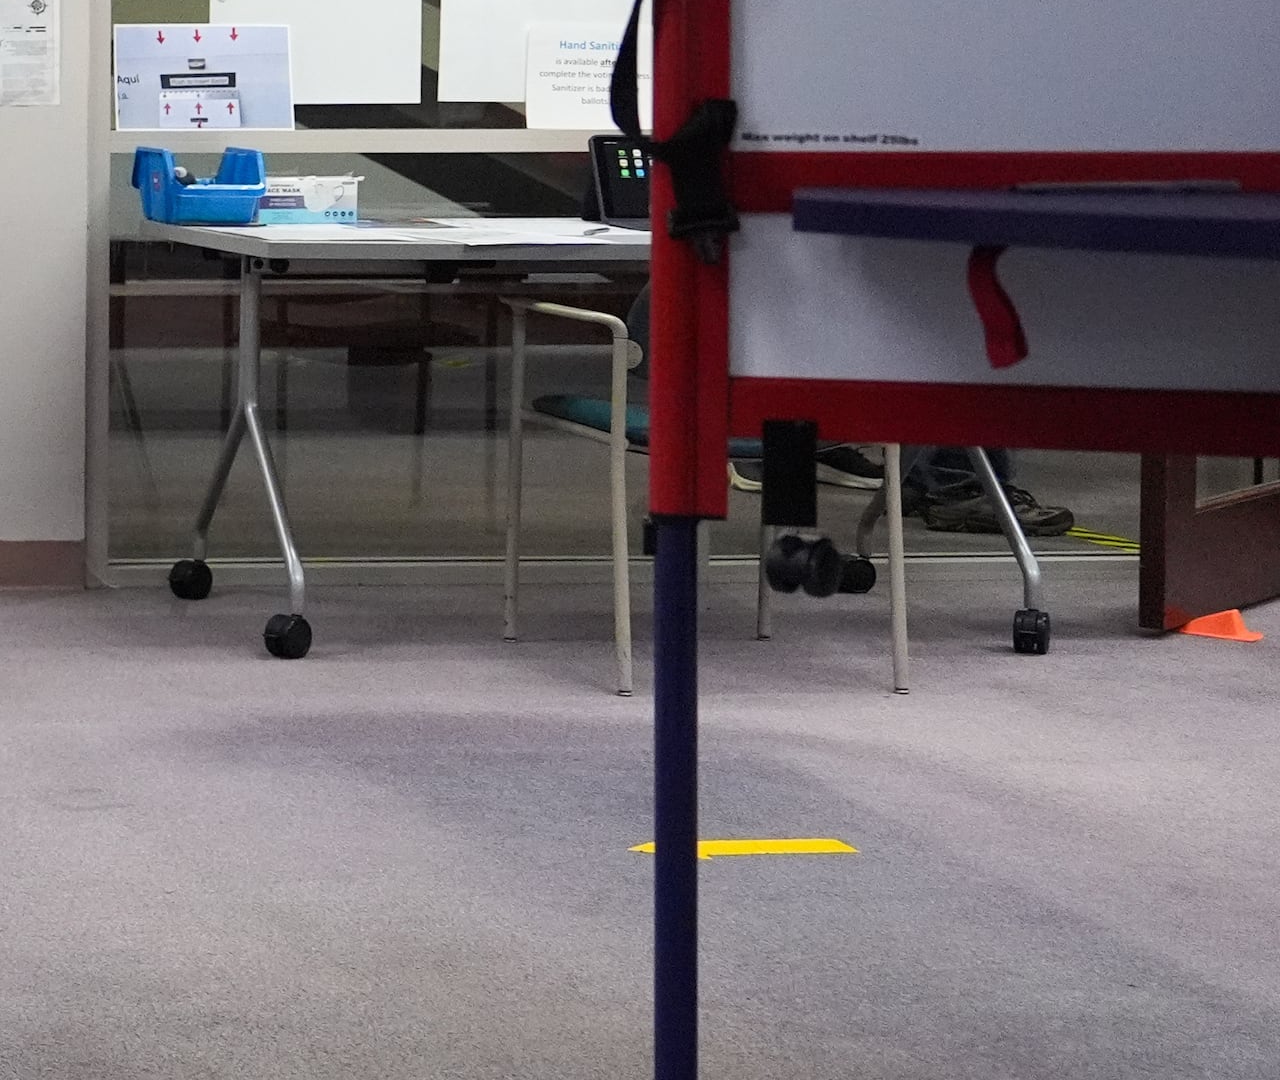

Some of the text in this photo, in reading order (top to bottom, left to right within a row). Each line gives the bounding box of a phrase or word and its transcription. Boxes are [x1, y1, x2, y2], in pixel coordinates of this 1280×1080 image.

[560, 40, 586, 50] Hand
[564, 58, 598, 66] available
[600, 59, 617, 67] afte
[540, 70, 576, 80] complete
[552, 84, 586, 92] Sanitizer
